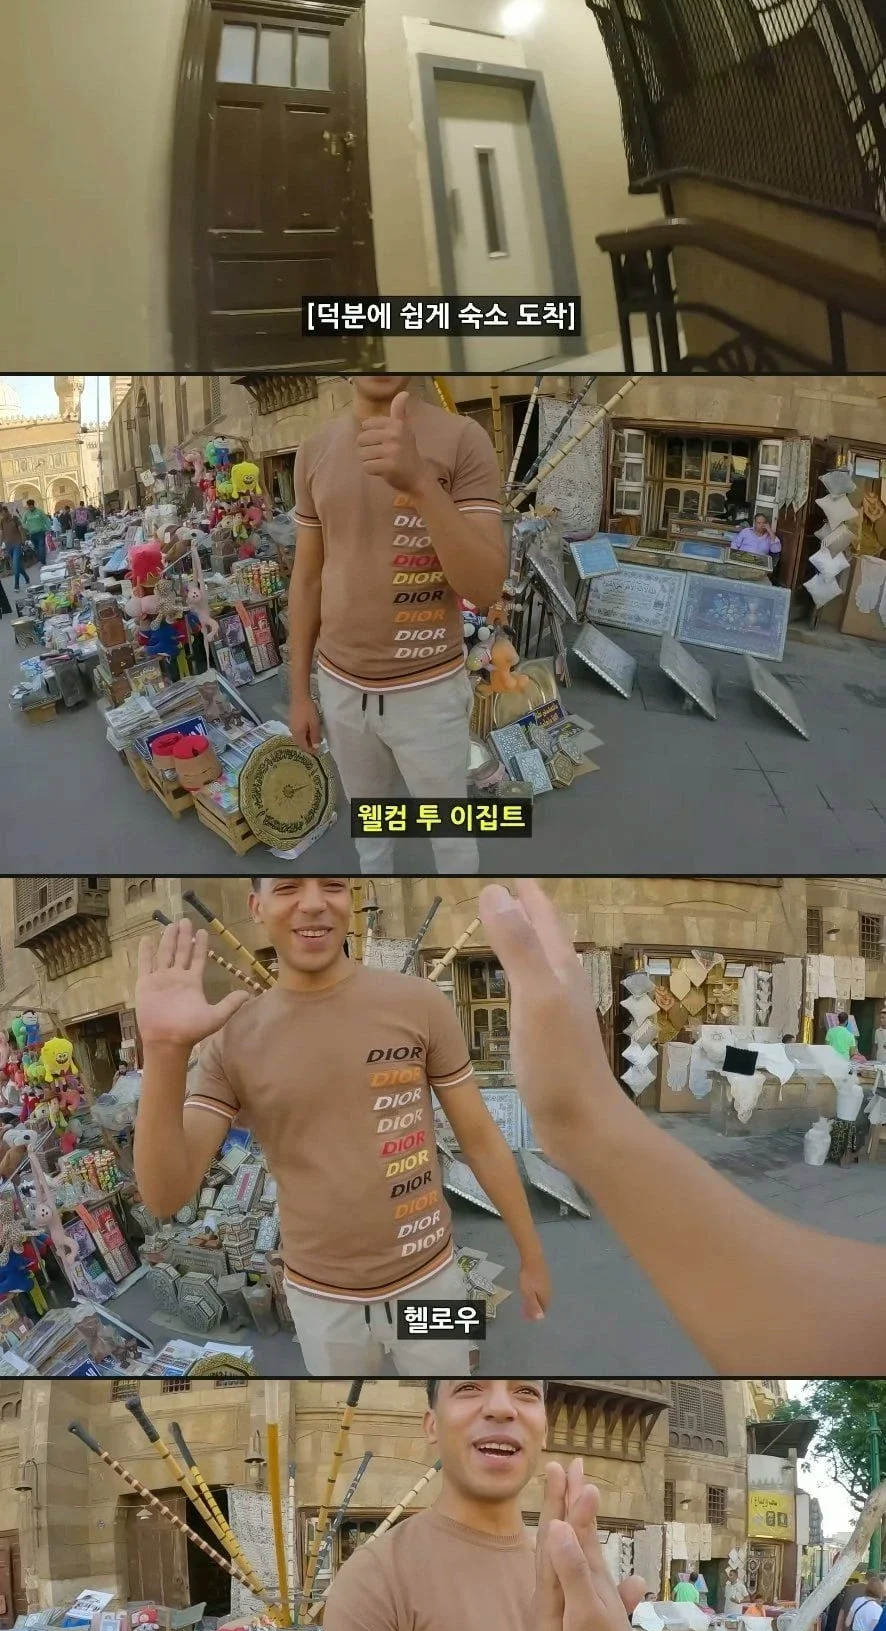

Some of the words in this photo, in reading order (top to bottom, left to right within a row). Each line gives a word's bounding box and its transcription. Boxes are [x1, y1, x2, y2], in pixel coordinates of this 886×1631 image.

[392, 571, 444, 585] DIOR
[393, 590, 444, 604] DIOR
[394, 608, 446, 624] DIOR
[394, 628, 447, 641] DIOR
[394, 644, 448, 659] DIOR
[366, 1046, 423, 1064] DIOR
[371, 1067, 421, 1088] DIOR
[373, 1087, 422, 1111] DIOR
[376, 1108, 423, 1134] DIOR
[382, 1130, 426, 1156] DIOR
[385, 1149, 429, 1178] DIOR
[390, 1170, 432, 1199] DIOR
[394, 1190, 439, 1219] DIOR
[397, 1209, 441, 1239] DIOR
[401, 1227, 445, 1258] DIOR
